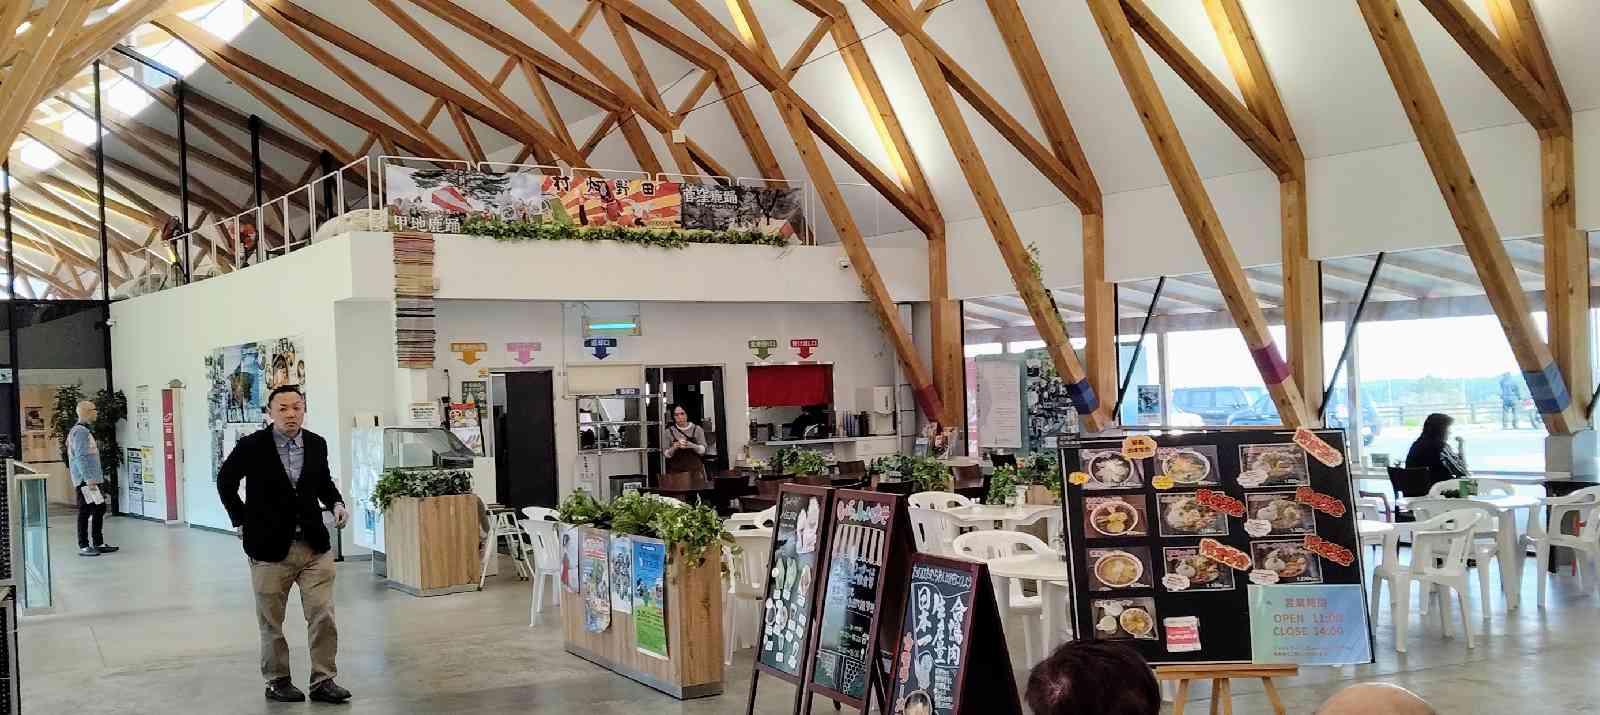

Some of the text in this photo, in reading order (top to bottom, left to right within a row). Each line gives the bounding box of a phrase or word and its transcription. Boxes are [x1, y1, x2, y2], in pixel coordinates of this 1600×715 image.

[394, 214, 461, 233] 甲地鹿踊
[916, 586, 933, 647] 日本一
[1273, 613, 1304, 624] OPEN
[1273, 626, 1309, 637] CLOSE
